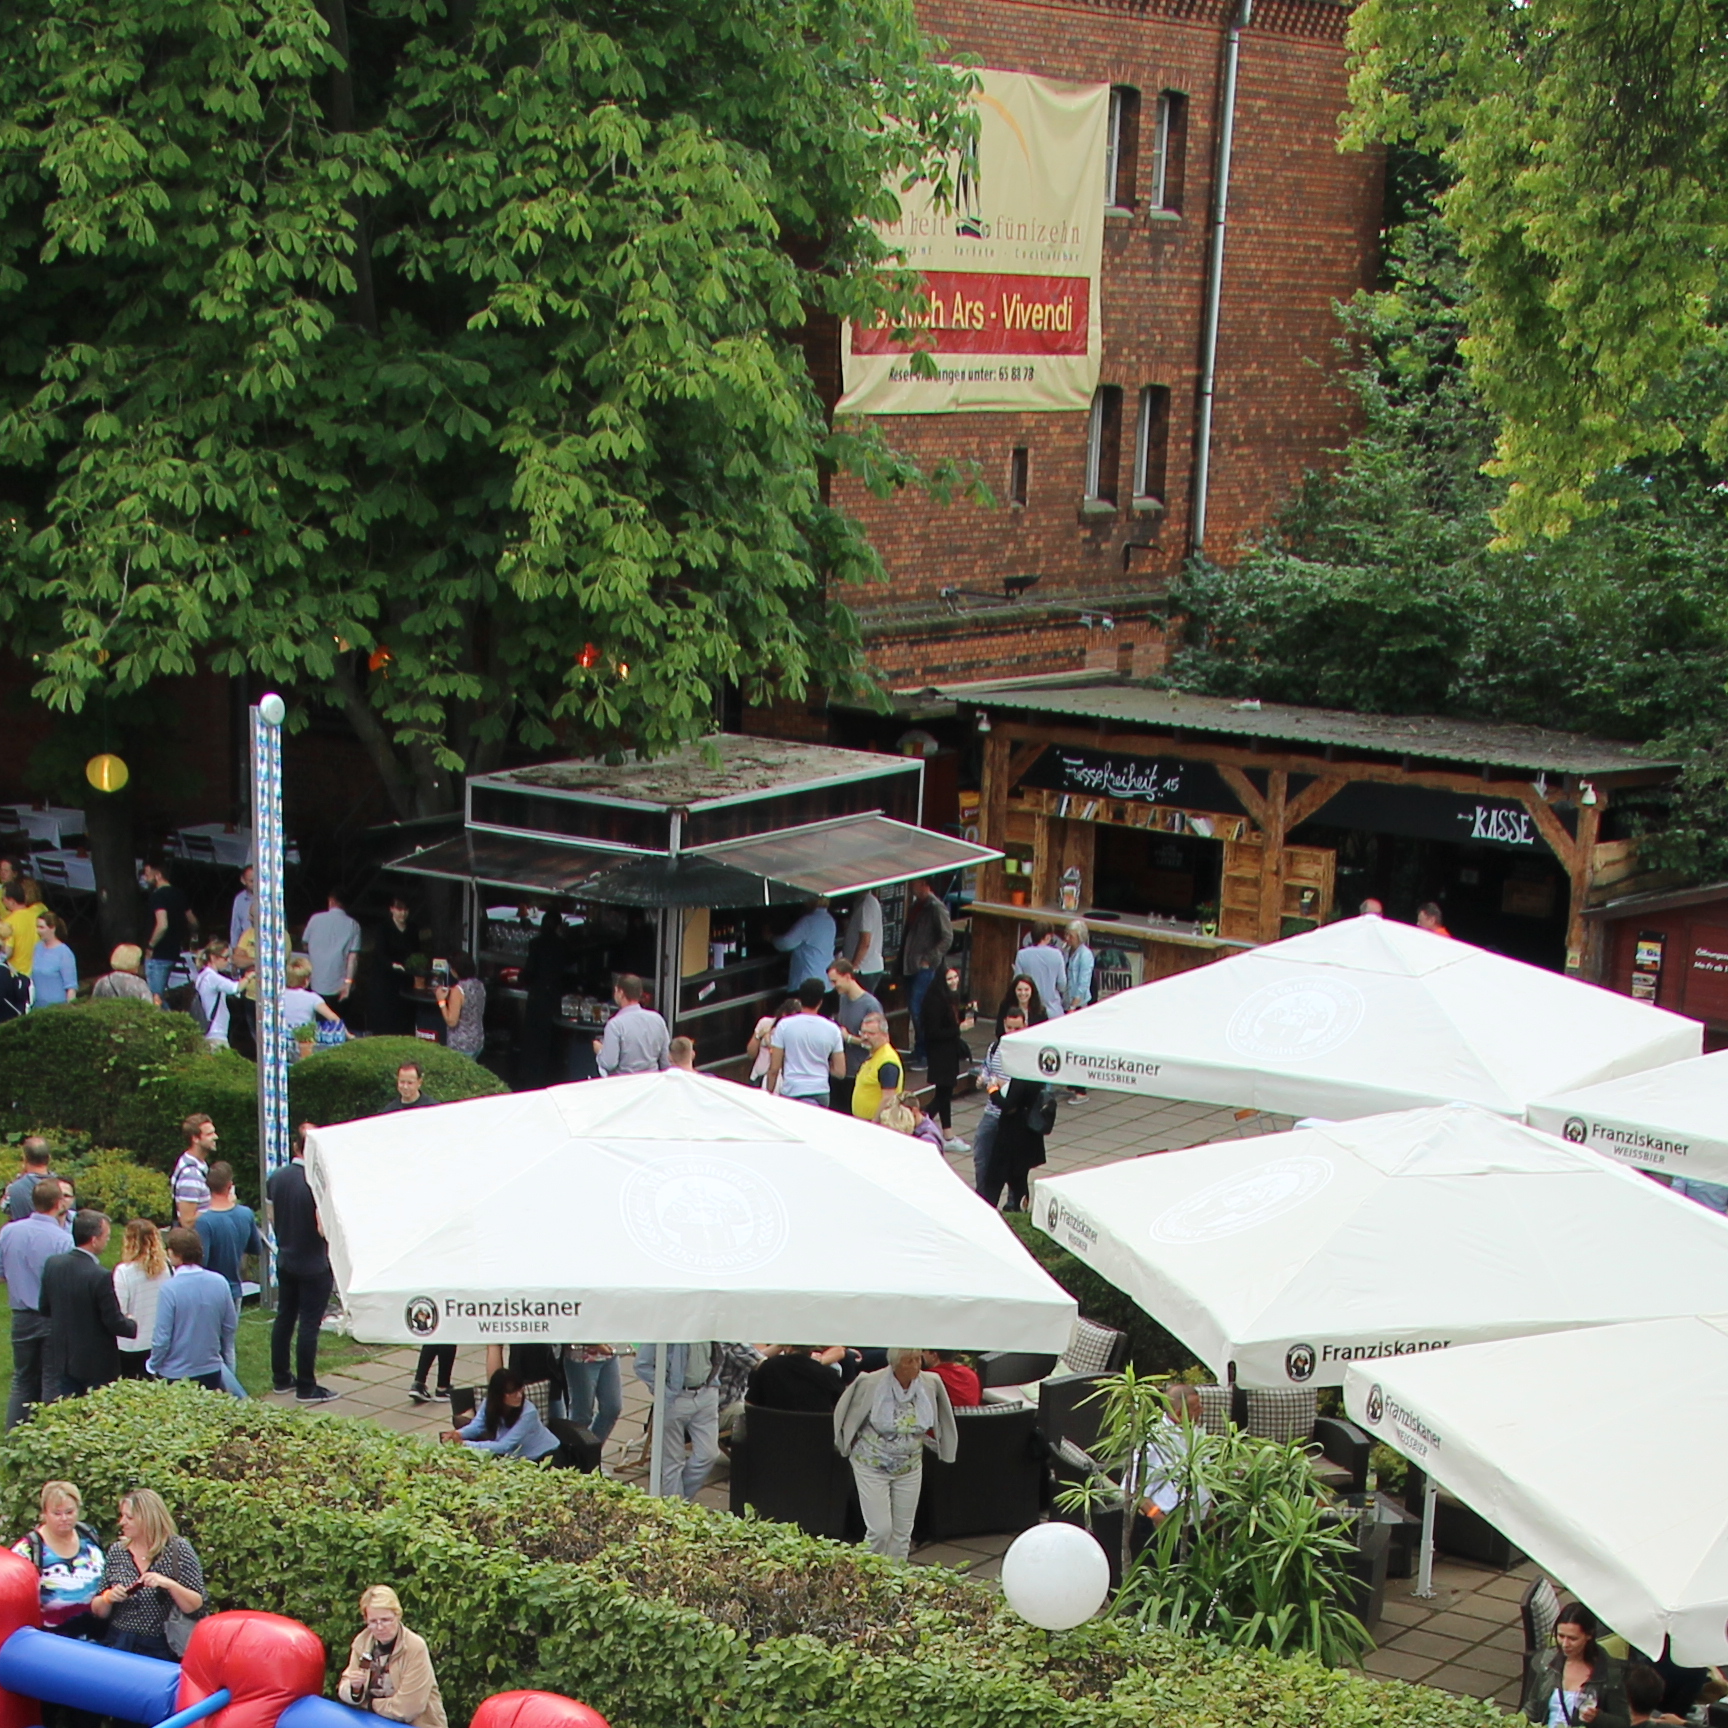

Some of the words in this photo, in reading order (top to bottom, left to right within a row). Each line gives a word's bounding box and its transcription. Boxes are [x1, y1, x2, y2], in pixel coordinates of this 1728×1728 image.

[996, 215, 1080, 244] fünfzehn
[952, 291, 985, 330] Ars
[1002, 292, 1073, 332] Vivendi
[1471, 806, 1535, 844] KASSE
[1101, 971, 1132, 991] KINO
[1065, 1049, 1162, 1077] Franziskaner
[1087, 1070, 1138, 1085] WEISSBIER
[1592, 1123, 1690, 1157] Franziskaner
[1613, 1145, 1666, 1164] WEISSBIER
[444, 1297, 582, 1317] Franziskaner
[478, 1321, 551, 1333] WEISSBIER
[1384, 1394, 1442, 1451] Franziskaner
